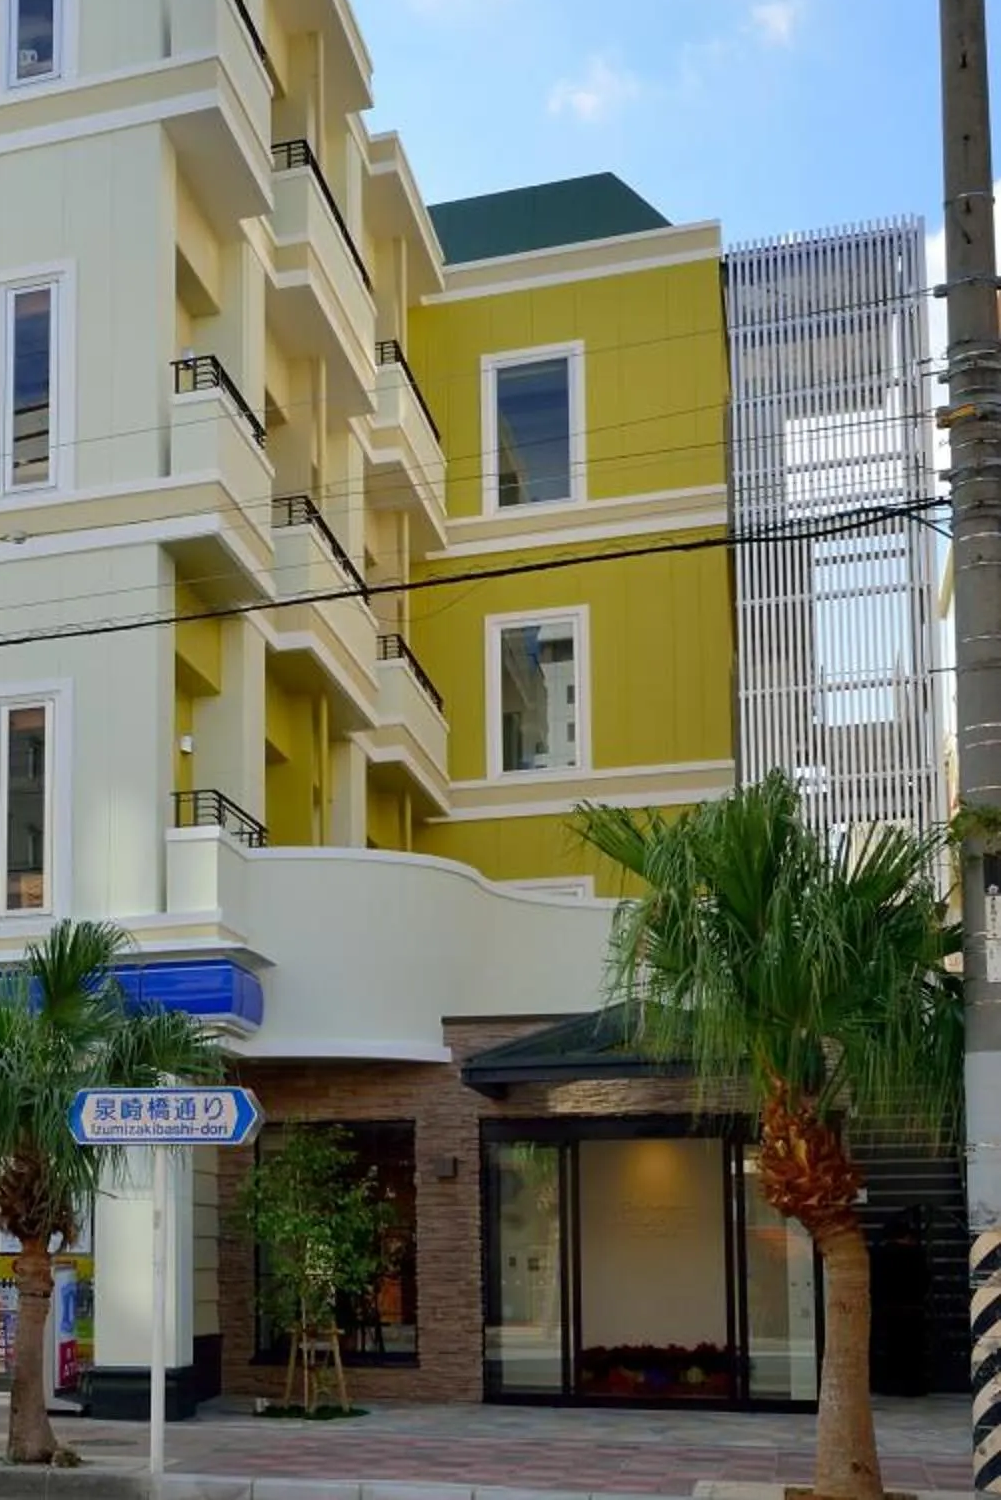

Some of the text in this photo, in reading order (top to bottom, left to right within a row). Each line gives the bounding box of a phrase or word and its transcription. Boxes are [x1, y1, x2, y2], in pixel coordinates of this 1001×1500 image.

[94, 1097, 224, 1121] 泉崎橋通り
[90, 1122, 228, 1136] Izumizakibashi-dori
